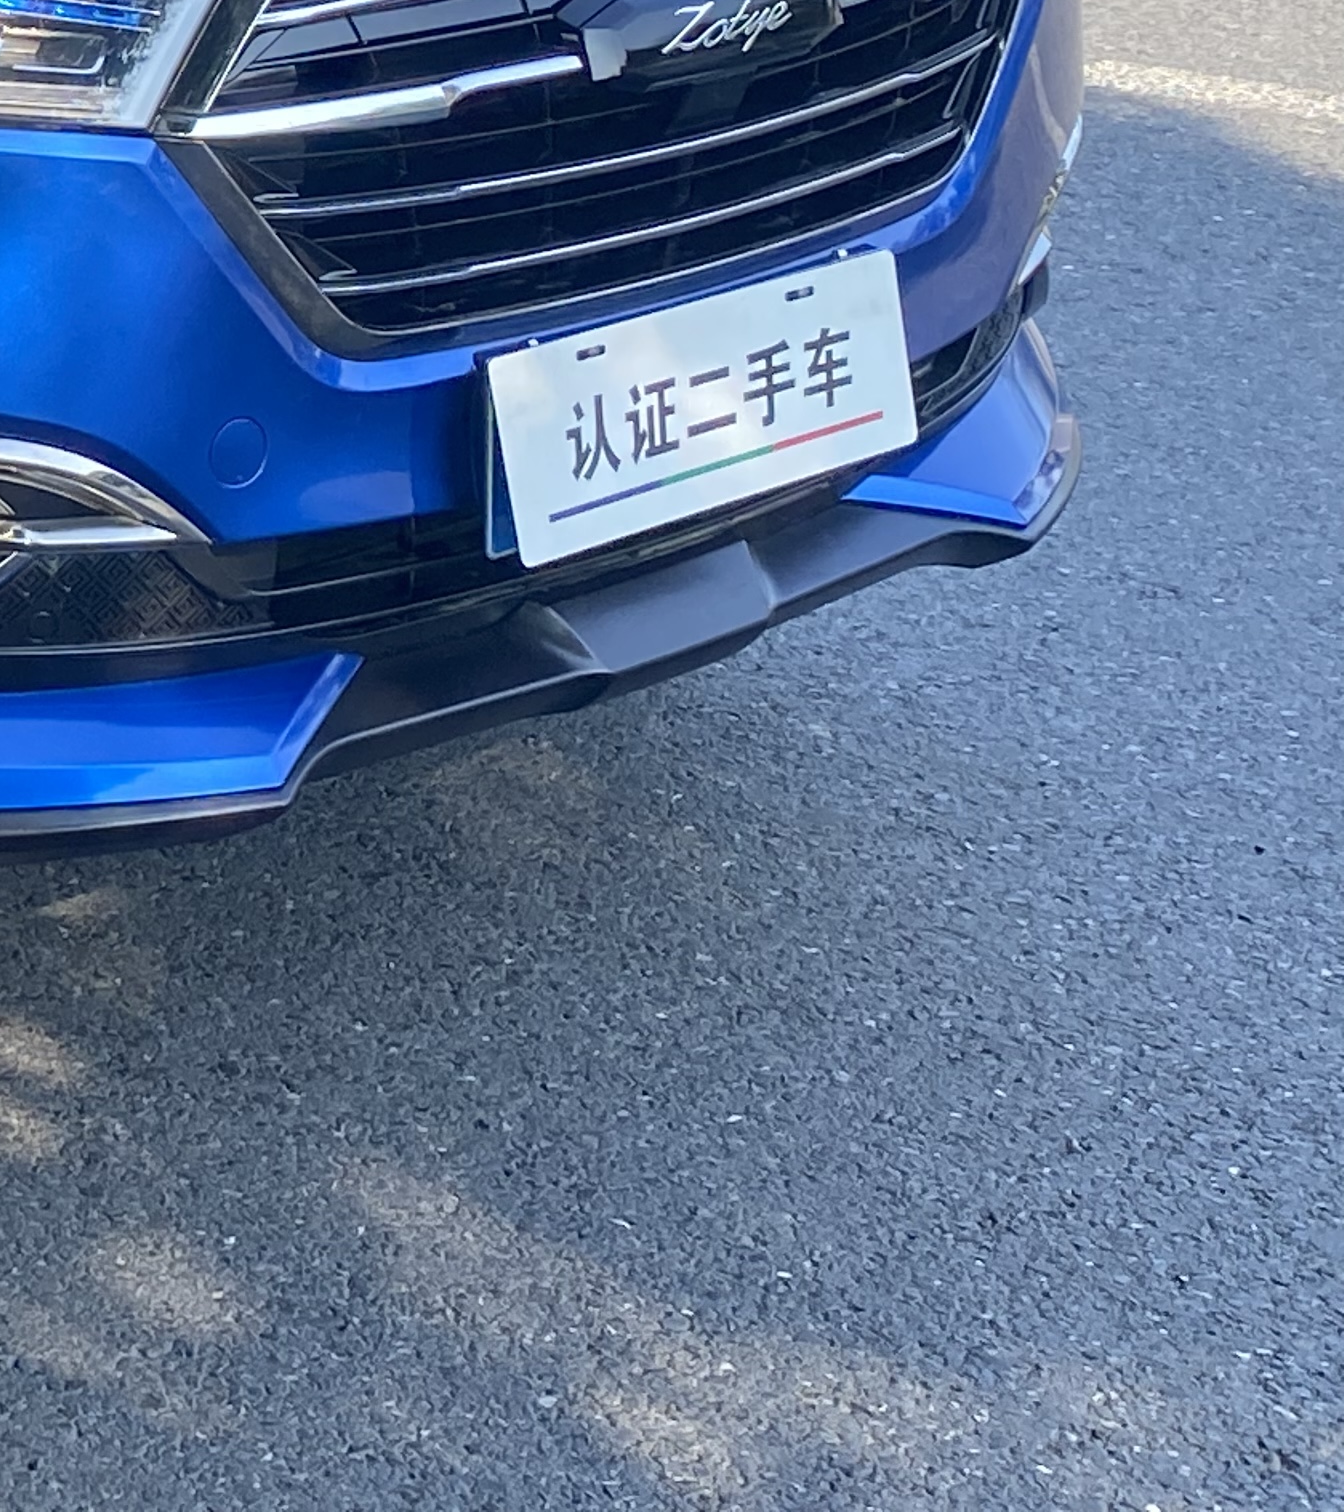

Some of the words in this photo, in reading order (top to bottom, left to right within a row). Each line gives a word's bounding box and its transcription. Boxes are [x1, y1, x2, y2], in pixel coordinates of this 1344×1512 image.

[565, 327, 853, 480] 认证二手车
